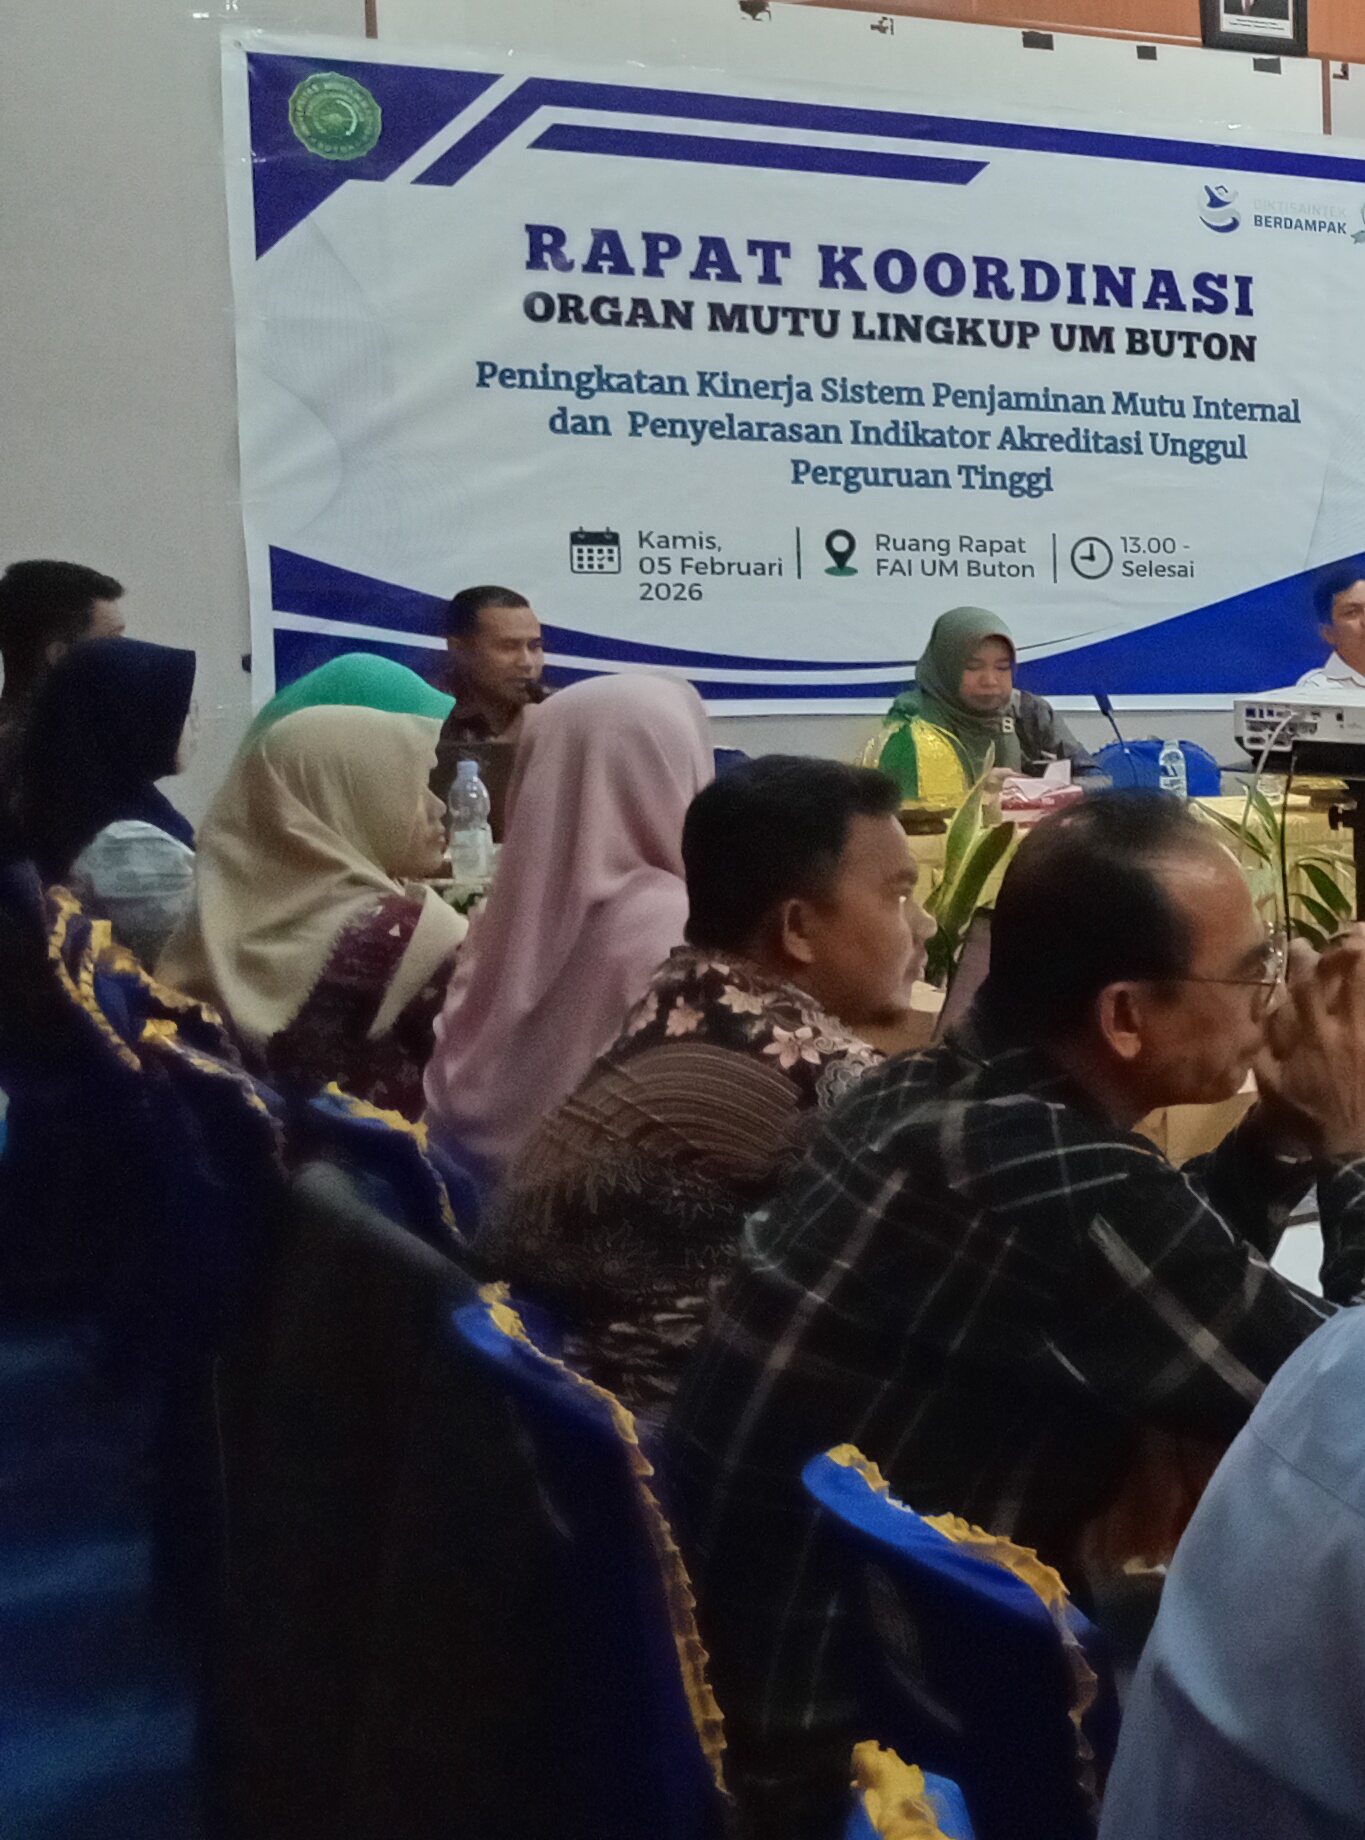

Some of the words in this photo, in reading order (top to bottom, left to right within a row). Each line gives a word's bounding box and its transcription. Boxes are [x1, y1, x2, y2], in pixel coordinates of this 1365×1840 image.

[1254, 215, 1347, 234] BERDAMPAK
[525, 223, 791, 285] RAPAT
[818, 244, 1254, 317] KOORDINASI
[523, 291, 694, 330] ORGAN
[707, 301, 841, 338] MUTU
[851, 310, 1040, 350] LINGKUP
[1050, 323, 1115, 354] UM
[1125, 327, 1257, 362] BUTON
[475, 360, 690, 399] Peningkatan
[697, 371, 814, 407] Kinerja
[821, 377, 926, 407] Sistem
[932, 382, 1106, 415] Penjaminan
[1111, 391, 1186, 419] Mutu
[1193, 395, 1302, 423] Internal
[548, 406, 612, 437] dan
[627, 410, 843, 445] Penyelarasan
[850, 419, 991, 450] Indikator
[997, 425, 1144, 455] Akreditasi
[1149, 431, 1248, 464] Unggul
[790, 458, 952, 494] Perguruan
[957, 464, 1054, 498] Tinggi
[638, 530, 722, 552] Kamis,
[875, 533, 950, 556] Ruang
[959, 535, 1027, 557] Rapat
[1120, 536, 1176, 554] 13.00
[639, 556, 672, 575] 05
[680, 557, 783, 576] Februari
[876, 559, 913, 577] FAI
[921, 560, 958, 577] UM
[967, 561, 1035, 578] Buton
[1121, 560, 1195, 578] Selesai
[639, 582, 704, 601] 2026
